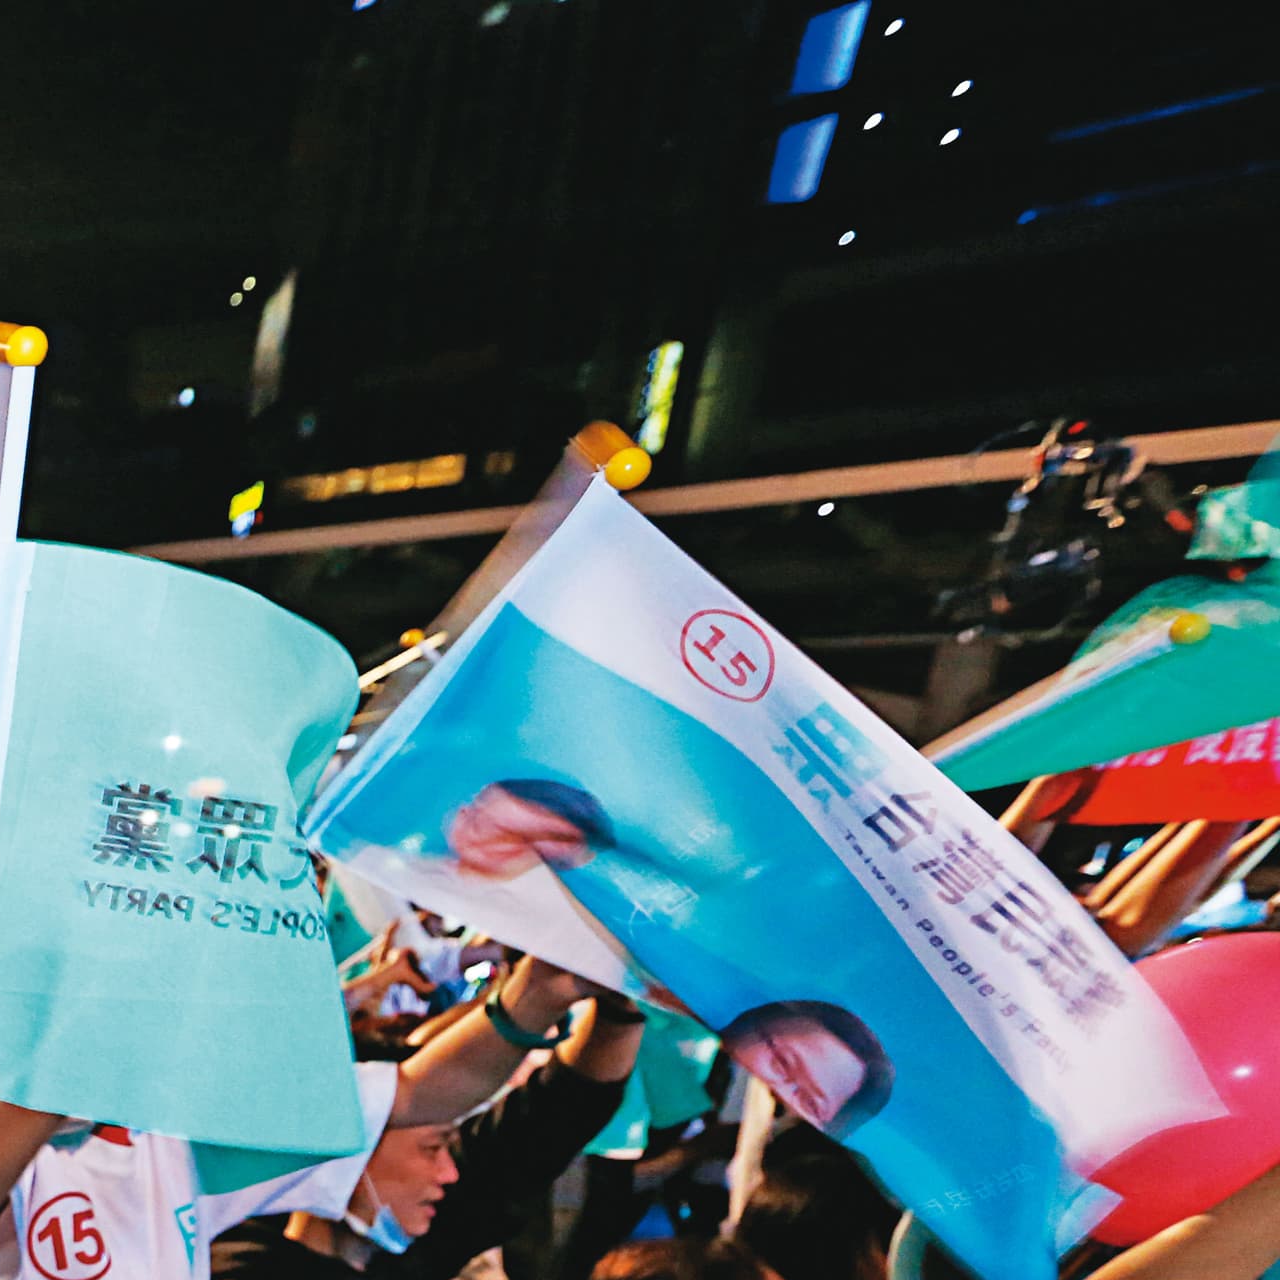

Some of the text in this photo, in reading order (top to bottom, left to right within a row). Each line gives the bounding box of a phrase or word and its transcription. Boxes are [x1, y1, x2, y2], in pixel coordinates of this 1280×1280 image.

[693, 623, 758, 688] 15
[842, 828, 912, 913] Taiwan
[915, 918, 1020, 1018] People's
[37, 1209, 106, 1271] 15
